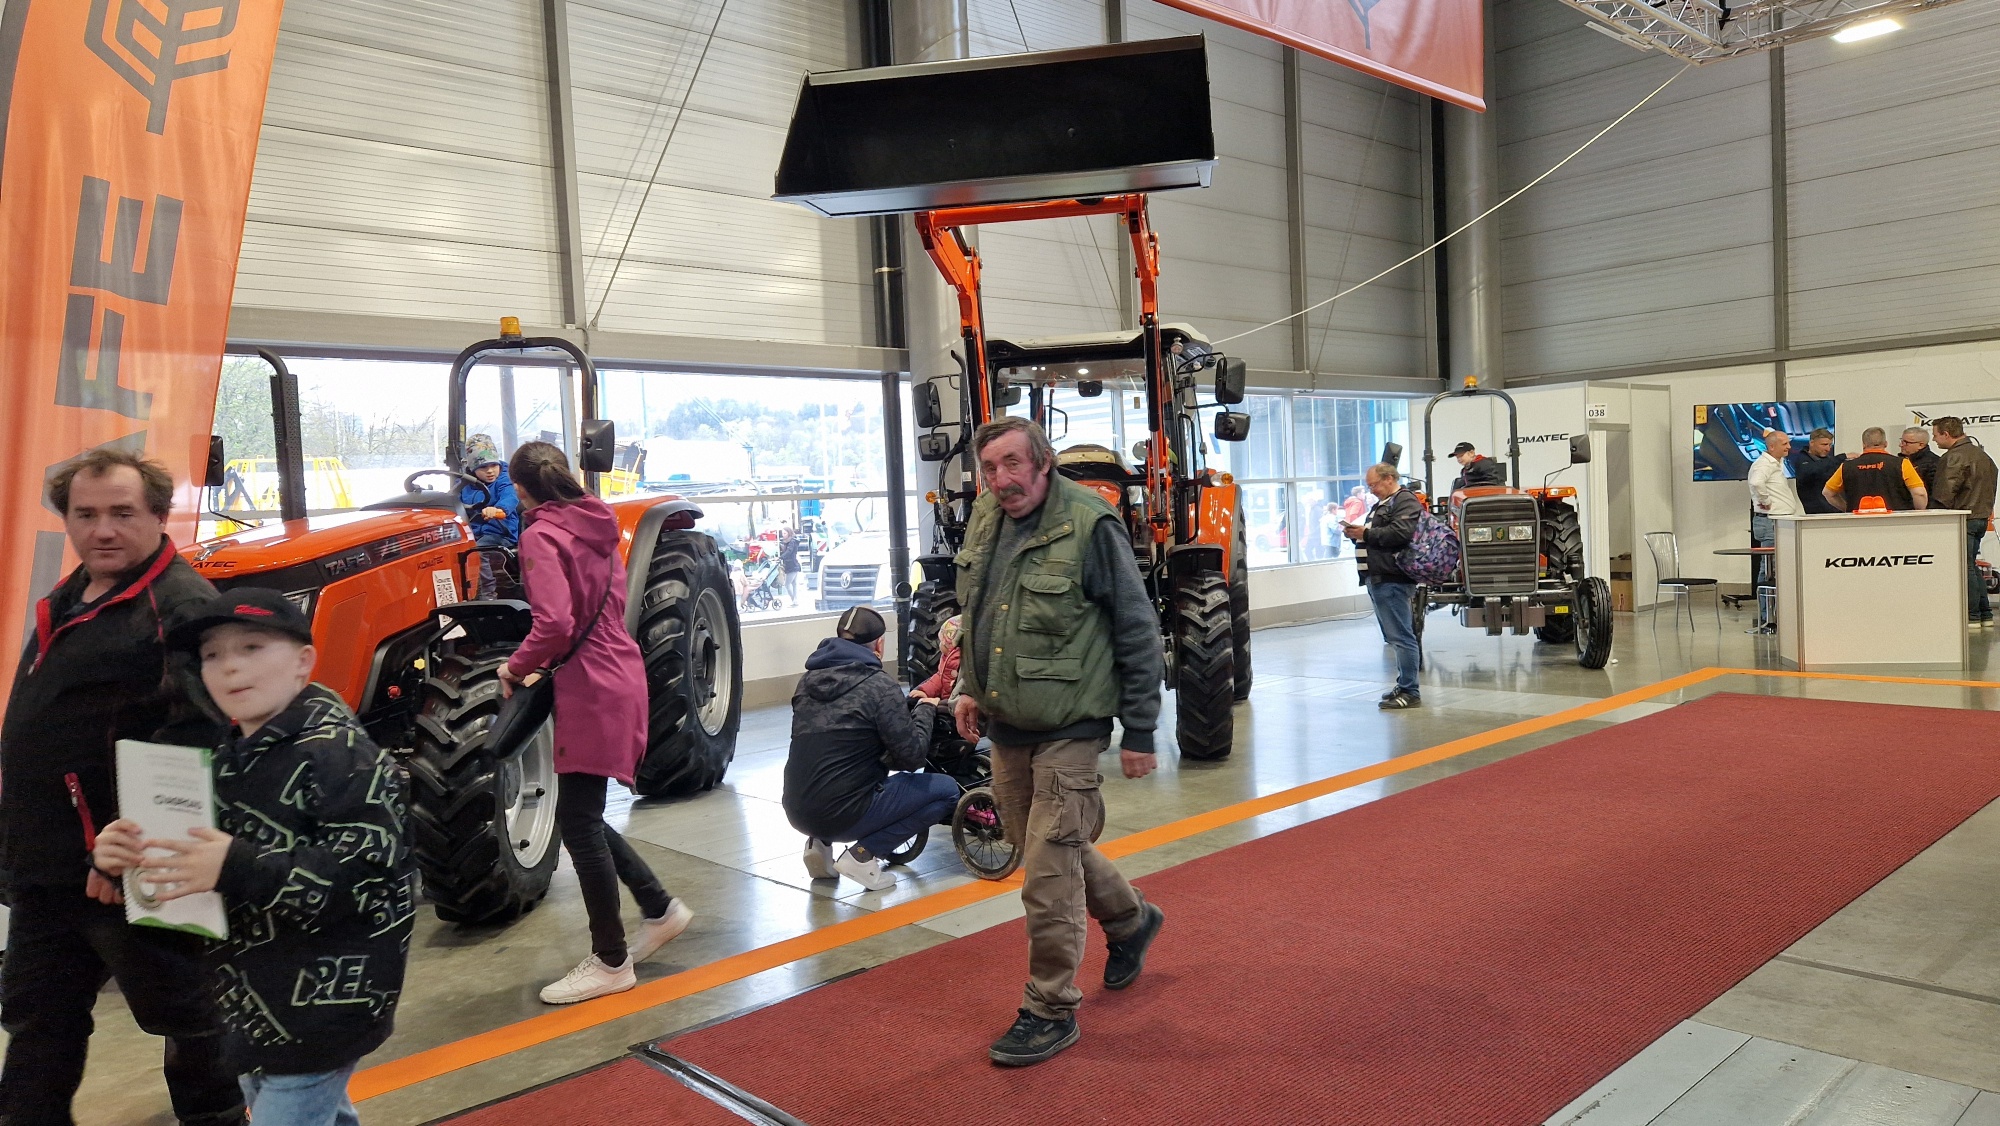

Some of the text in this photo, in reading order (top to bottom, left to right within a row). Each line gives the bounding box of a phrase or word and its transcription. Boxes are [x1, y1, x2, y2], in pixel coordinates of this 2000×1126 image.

[1588, 408, 1605, 417] 038
[1920, 414, 2000, 427] KATEC
[191, 561, 237, 569] ATEC
[1825, 555, 1934, 568] KOMATEC
